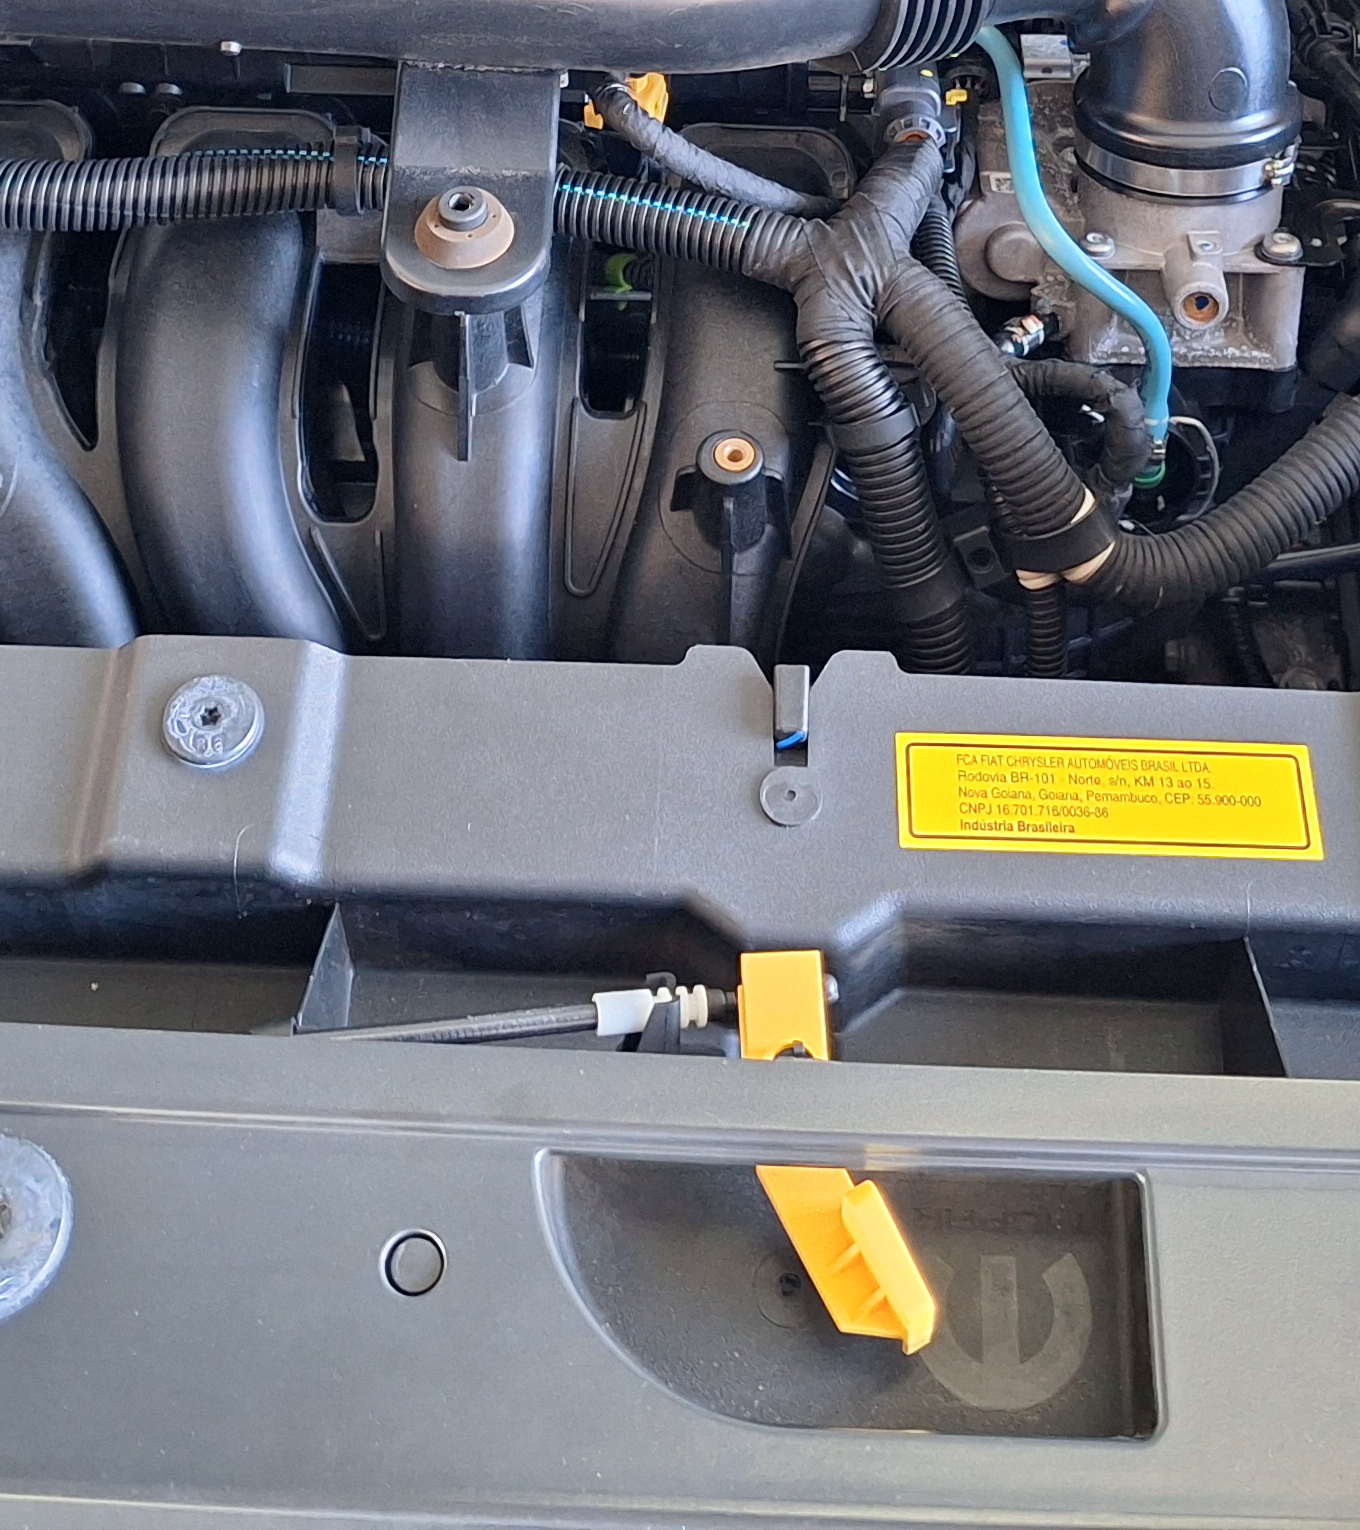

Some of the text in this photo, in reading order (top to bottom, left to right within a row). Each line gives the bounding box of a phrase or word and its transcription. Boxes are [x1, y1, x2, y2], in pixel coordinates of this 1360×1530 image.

[956, 753, 978, 766] FCA
[980, 754, 1003, 766] FIAT
[1006, 755, 1064, 769] CHRYSLER
[1067, 756, 1139, 771] AUTOMÓVEIS
[1141, 759, 1179, 772] BRASIL
[958, 769, 1007, 783] Rodovia
[1010, 771, 1055, 784] BR-101
[1134, 775, 1155, 788] KM
[1159, 776, 1174, 789] 13
[1176, 779, 1193, 789] ao
[958, 786, 988, 798] Nova
[991, 787, 1036, 801] Goiana,
[1039, 788, 1083, 803] Goiana,
[959, 802, 992, 815] CNPJ
[960, 819, 1076, 834] Indústria Brasileira
